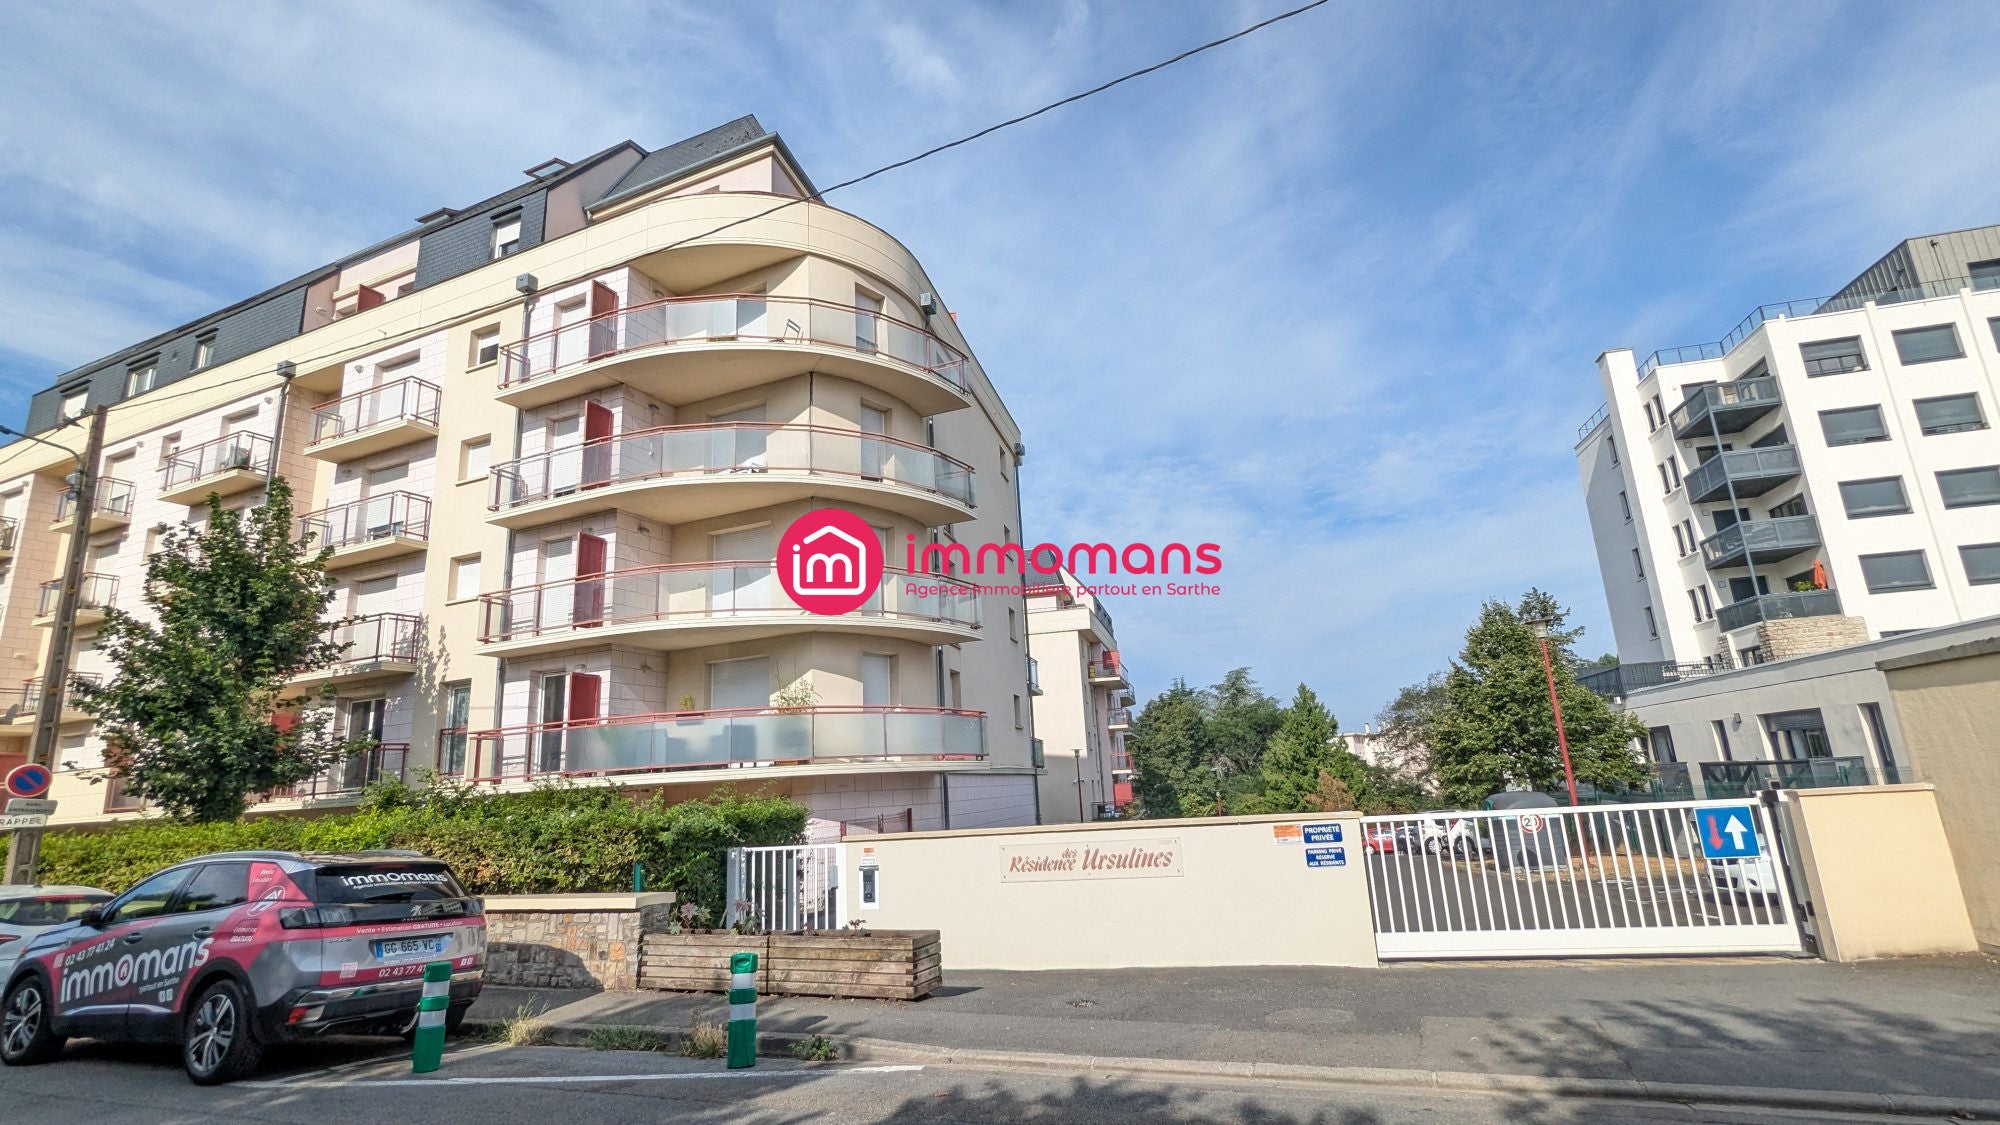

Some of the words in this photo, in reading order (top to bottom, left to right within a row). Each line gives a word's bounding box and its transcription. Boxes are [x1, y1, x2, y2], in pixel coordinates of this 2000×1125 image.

[1009, 856, 1077, 873] Résidence
[1082, 847, 1173, 870] Ursulines
[340, 872, 448, 886] immomans
[381, 924, 412, 932] Estimation
[60, 937, 215, 1004] immomans
[379, 967, 391, 978] 02
[392, 965, 405, 976] 43
[405, 964, 416, 975] 77
